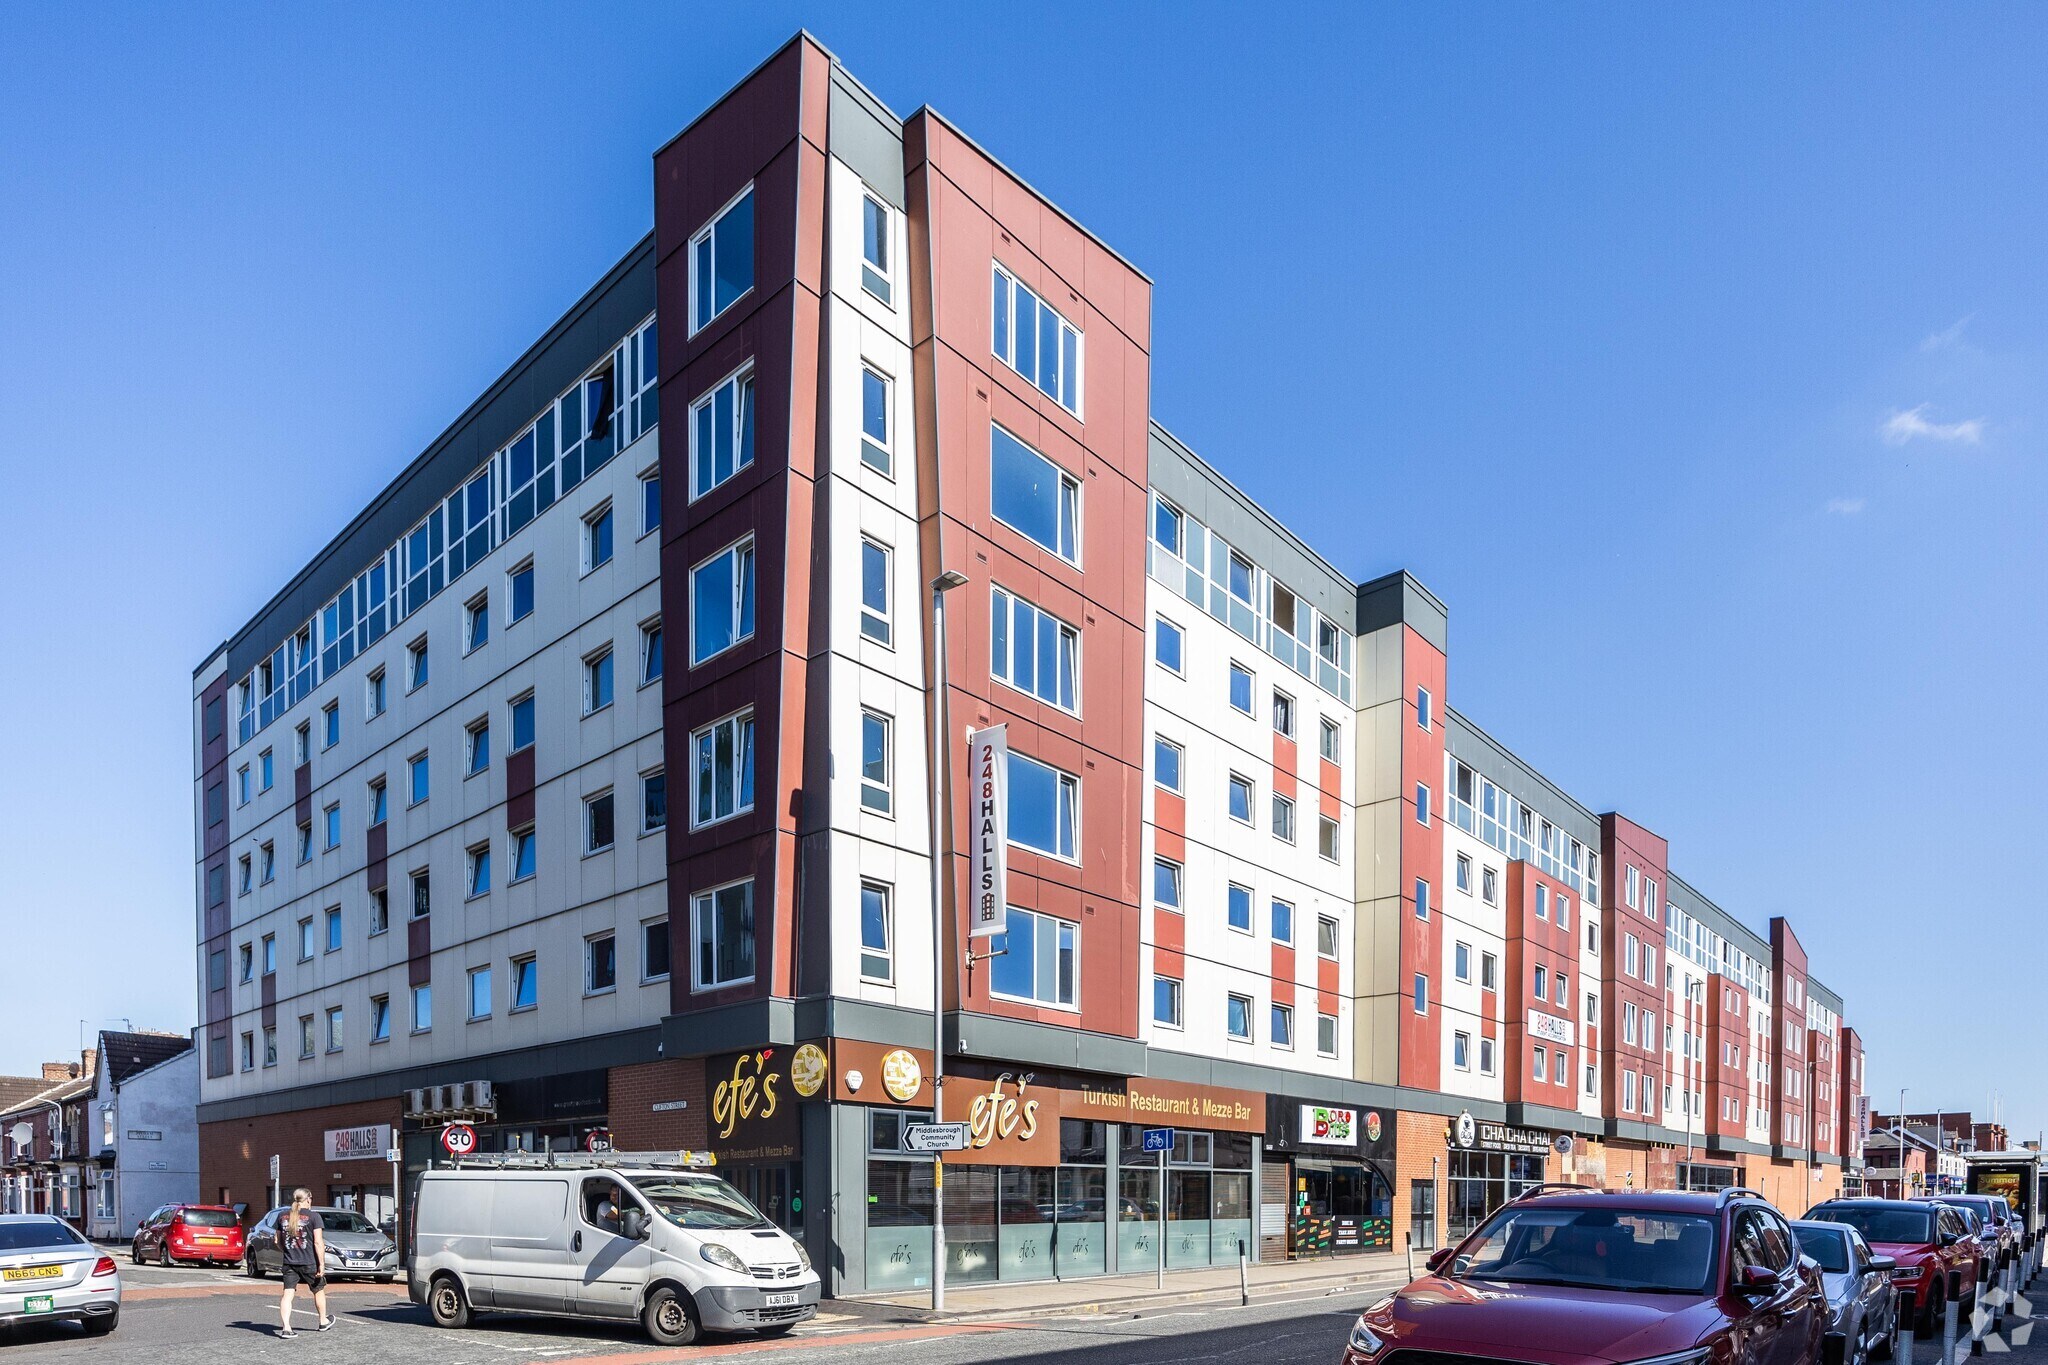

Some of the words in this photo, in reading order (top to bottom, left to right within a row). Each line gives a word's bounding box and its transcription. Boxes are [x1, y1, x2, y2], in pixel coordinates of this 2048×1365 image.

[981, 744, 994, 890] 248HALLS
[713, 1051, 781, 1139] efe's
[1081, 1083, 1126, 1108] Turkish
[1130, 1090, 1190, 1115] Restaurant
[1192, 1098, 1200, 1116] &
[1202, 1099, 1233, 1119] Mezze
[1235, 1102, 1251, 1121] Bar
[970, 1072, 1039, 1149] efe's
[335, 1128, 372, 1151] 248HALLS
[449, 1132, 471, 1146] 30
[915, 1126, 961, 1134] Middlesbrough
[1482, 1124, 1505, 1141] CHA
[1506, 1127, 1526, 1144] CHA
[1528, 1130, 1551, 1146] CHAI
[730, 1147, 759, 1159] Restaurant
[765, 1146, 783, 1157] Mezze
[783, 1144, 794, 1156] Bar
[890, 1244, 912, 1265] efe's
[7, 1268, 36, 1279] N666
[38, 1267, 59, 1276] CNS
[782, 1294, 795, 1303] DBX
